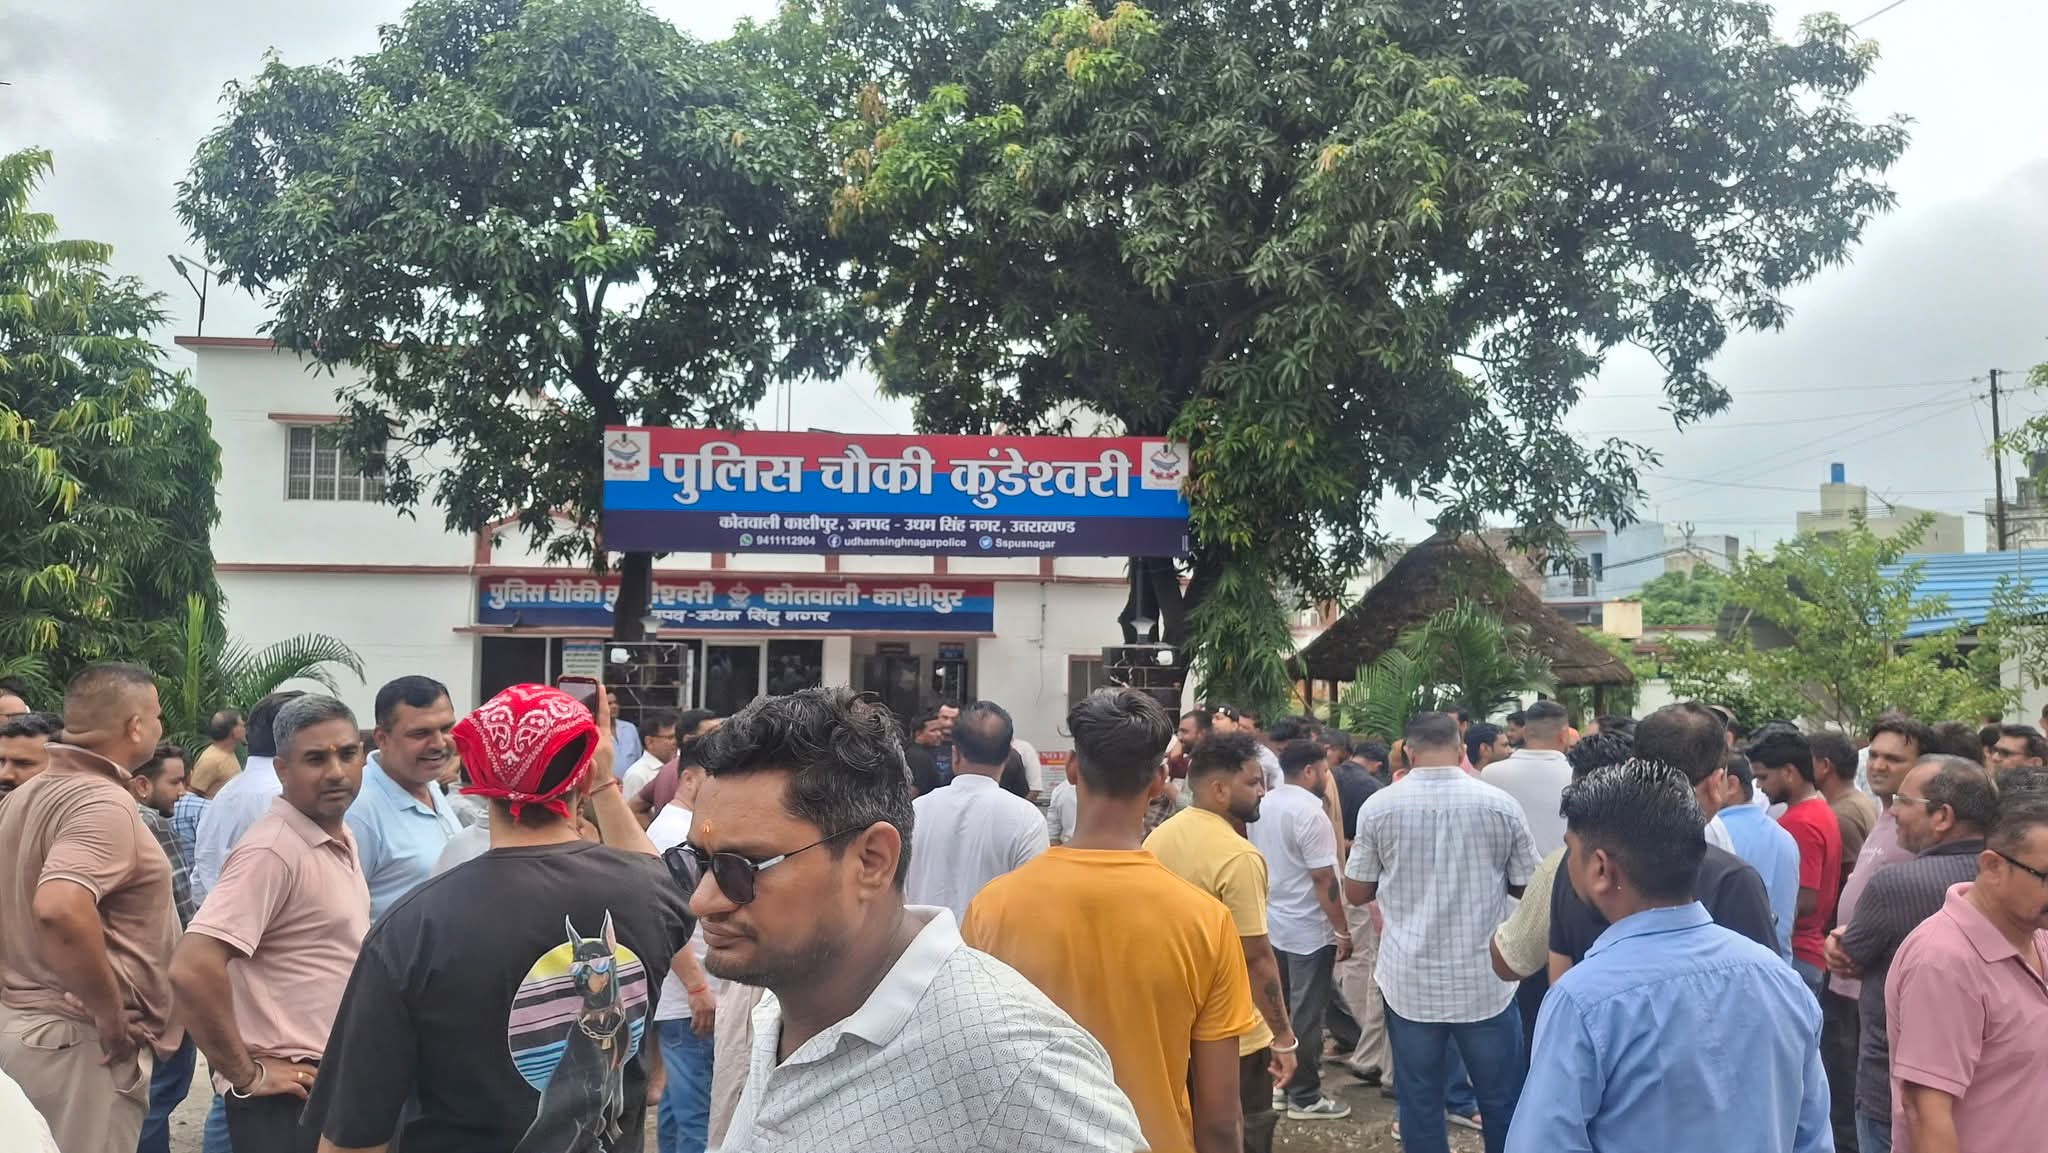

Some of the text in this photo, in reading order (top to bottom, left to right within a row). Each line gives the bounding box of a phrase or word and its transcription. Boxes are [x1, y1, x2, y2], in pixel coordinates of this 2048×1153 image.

[660, 441, 1132, 509] पुलिस चौकी कुंडेश्वरी
[718, 513, 780, 530] कोतवाली
[784, 514, 844, 534] काशीपुर,
[848, 518, 891, 531] जनपद
[939, 516, 966, 532] सिंह
[969, 519, 1007, 534] नगर,
[756, 535, 816, 546] 9411112904
[844, 535, 967, 548] udhamsinghnagarpolice
[995, 537, 1056, 550] Sspusnagar
[488, 578, 547, 610] पुलिस
[549, 578, 602, 603] चौकी
[747, 606, 781, 626] सिंह
